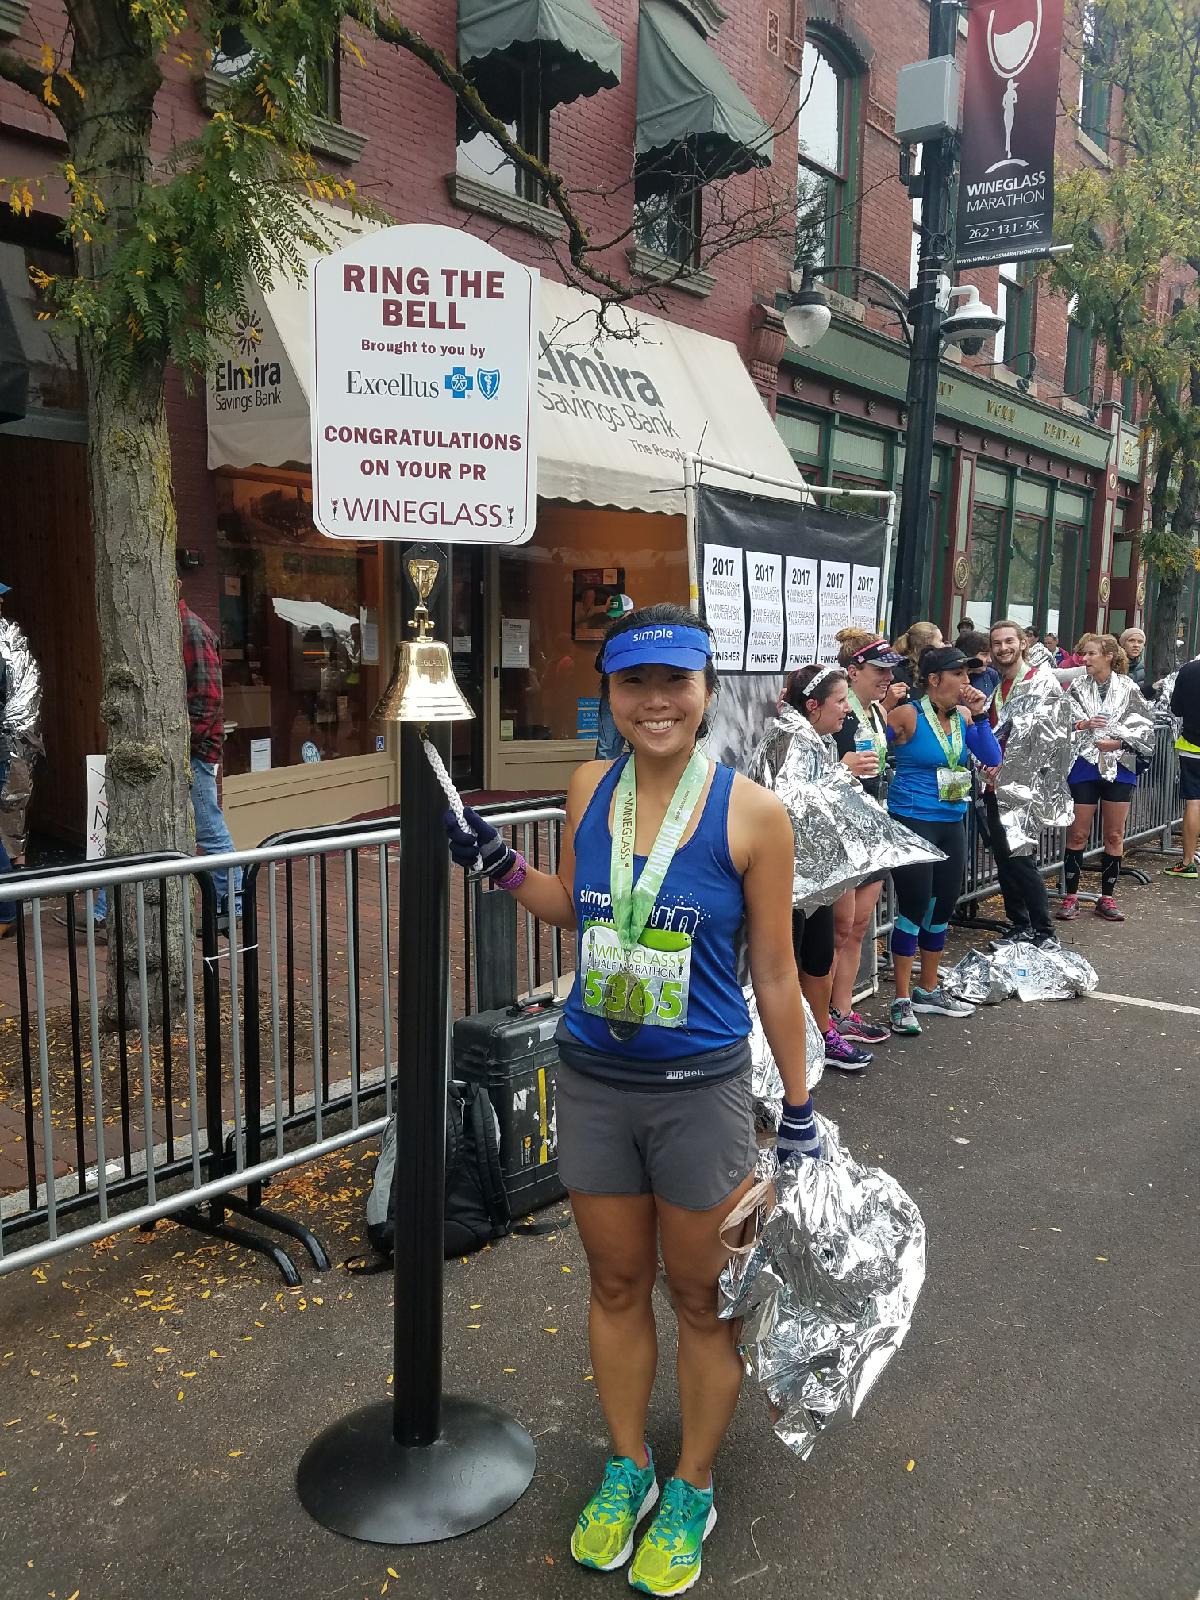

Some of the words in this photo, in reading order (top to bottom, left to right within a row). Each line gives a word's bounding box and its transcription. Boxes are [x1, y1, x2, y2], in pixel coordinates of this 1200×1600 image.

[966, 171, 1046, 196] WINEGLASS
[966, 189, 1046, 213] MARATHON
[968, 227, 990, 240] 26.2
[998, 223, 1017, 235] 13.1
[1025, 220, 1040, 231] 5K
[343, 264, 430, 296] RING
[441, 268, 505, 299] THE
[382, 298, 467, 330] BELL
[361, 339, 418, 357] Brought
[421, 342, 436, 354] to
[440, 345, 465, 357] you
[470, 344, 486, 359] by
[215, 357, 280, 391] Elmira
[345, 370, 440, 398] Excellus
[215, 393, 253, 413] Savings
[255, 387, 282, 407] Bank
[537, 381, 626, 433] Savings
[621, 402, 681, 439] Bank
[324, 425, 522, 451] CONGRATULATIONS
[628, 438, 653, 455] The
[360, 459, 389, 476] ON
[396, 460, 452, 480] YOUR
[459, 464, 486, 481] PR
[342, 497, 502, 528] WINEGLASS
[712, 557, 735, 577] 2017
[755, 563, 775, 583] 2017
[792, 568, 811, 586] 2017
[826, 572, 845, 589] 2017
[857, 576, 874, 592] 2017
[633, 628, 674, 642] simple
[711, 651, 740, 661] FINISHER
[750, 653, 779, 664] FINISHER
[789, 654, 813, 664] FINISHER
[820, 655, 839, 664] FINISH
[620, 797, 634, 860] WINEGLASS
[648, 821, 682, 877] ANNUAL
[580, 883, 613, 907] simp
[594, 958, 617, 971] HALF
[618, 962, 677, 979] MARATHON
[583, 969, 684, 1020] 5365
